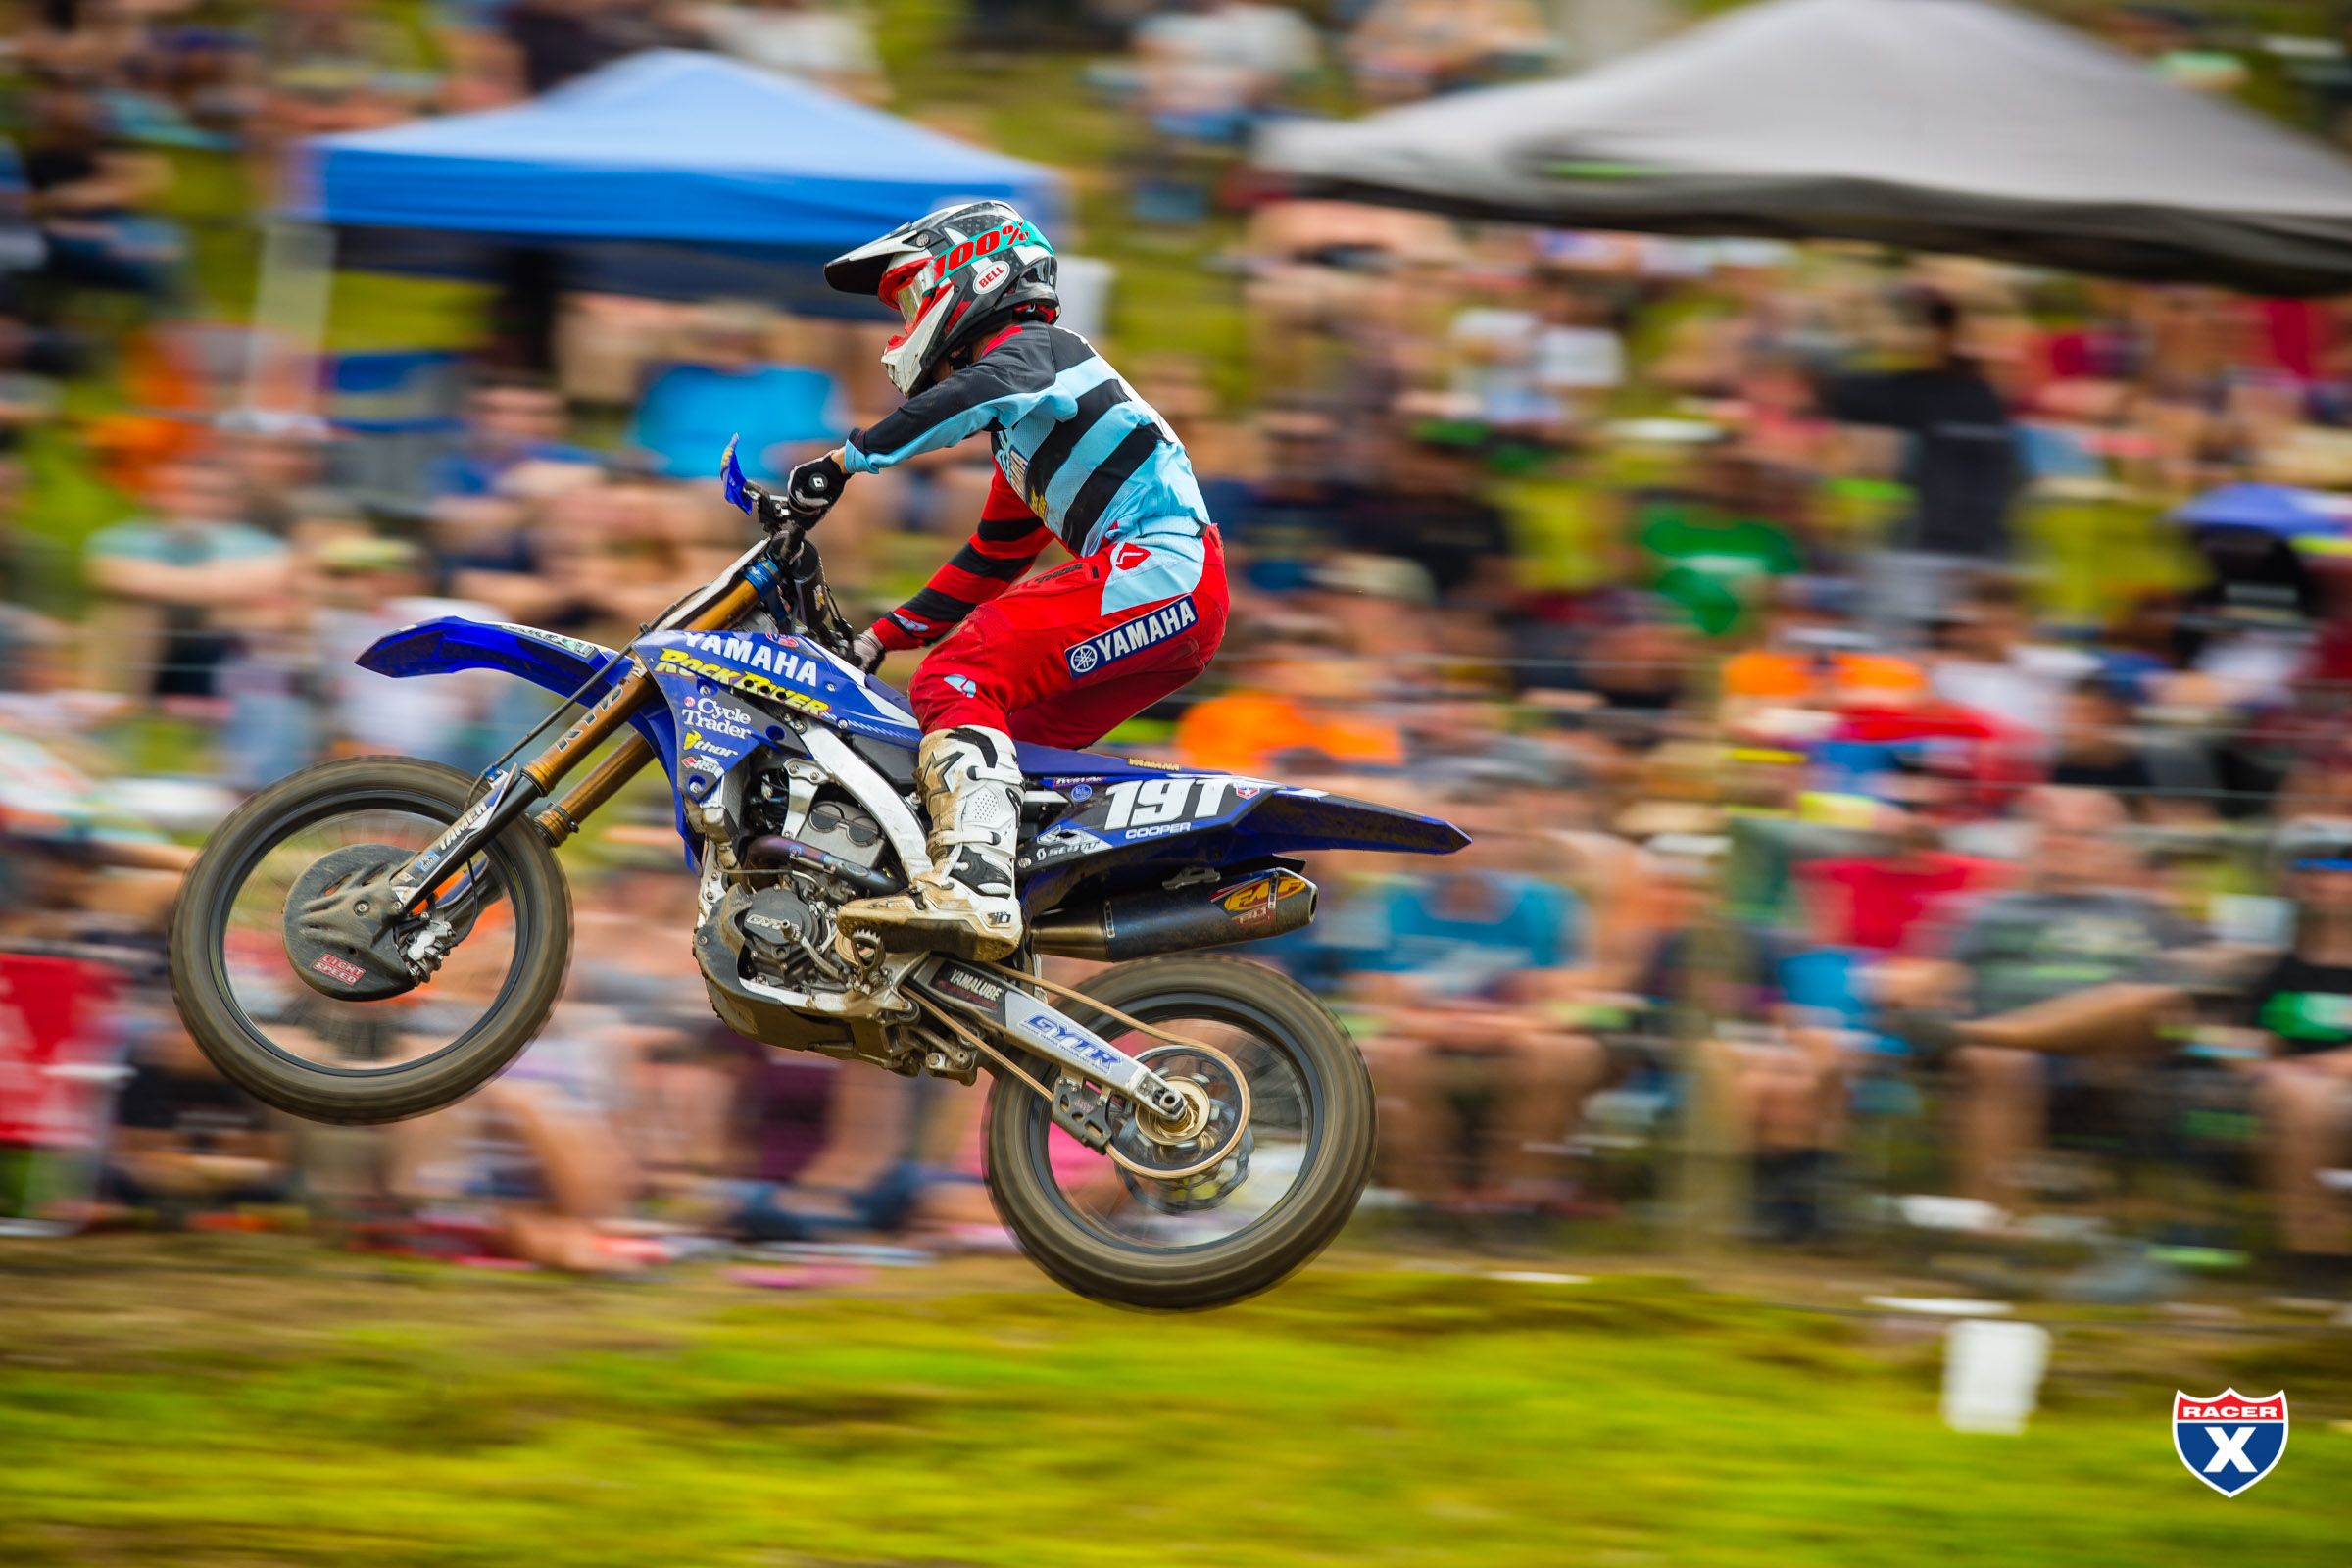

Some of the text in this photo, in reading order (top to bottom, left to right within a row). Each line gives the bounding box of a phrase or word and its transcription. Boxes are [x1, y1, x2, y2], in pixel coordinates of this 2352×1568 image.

[929, 221, 1030, 285] 100%
[977, 266, 1005, 289] BELL
[1034, 562, 1084, 584] THOR
[1096, 599, 1197, 662] YAMAHA
[653, 647, 743, 687] ROCK
[683, 630, 818, 688] YAMAHA
[681, 708, 753, 740] Trader
[697, 697, 752, 725] Cycle
[1125, 821, 1192, 840] COOPER
[314, 962, 357, 984] SPEED
[321, 955, 364, 976] LIGHT
[949, 968, 1003, 1002] YAMALUBE
[1026, 1015, 1121, 1071] GYTR
